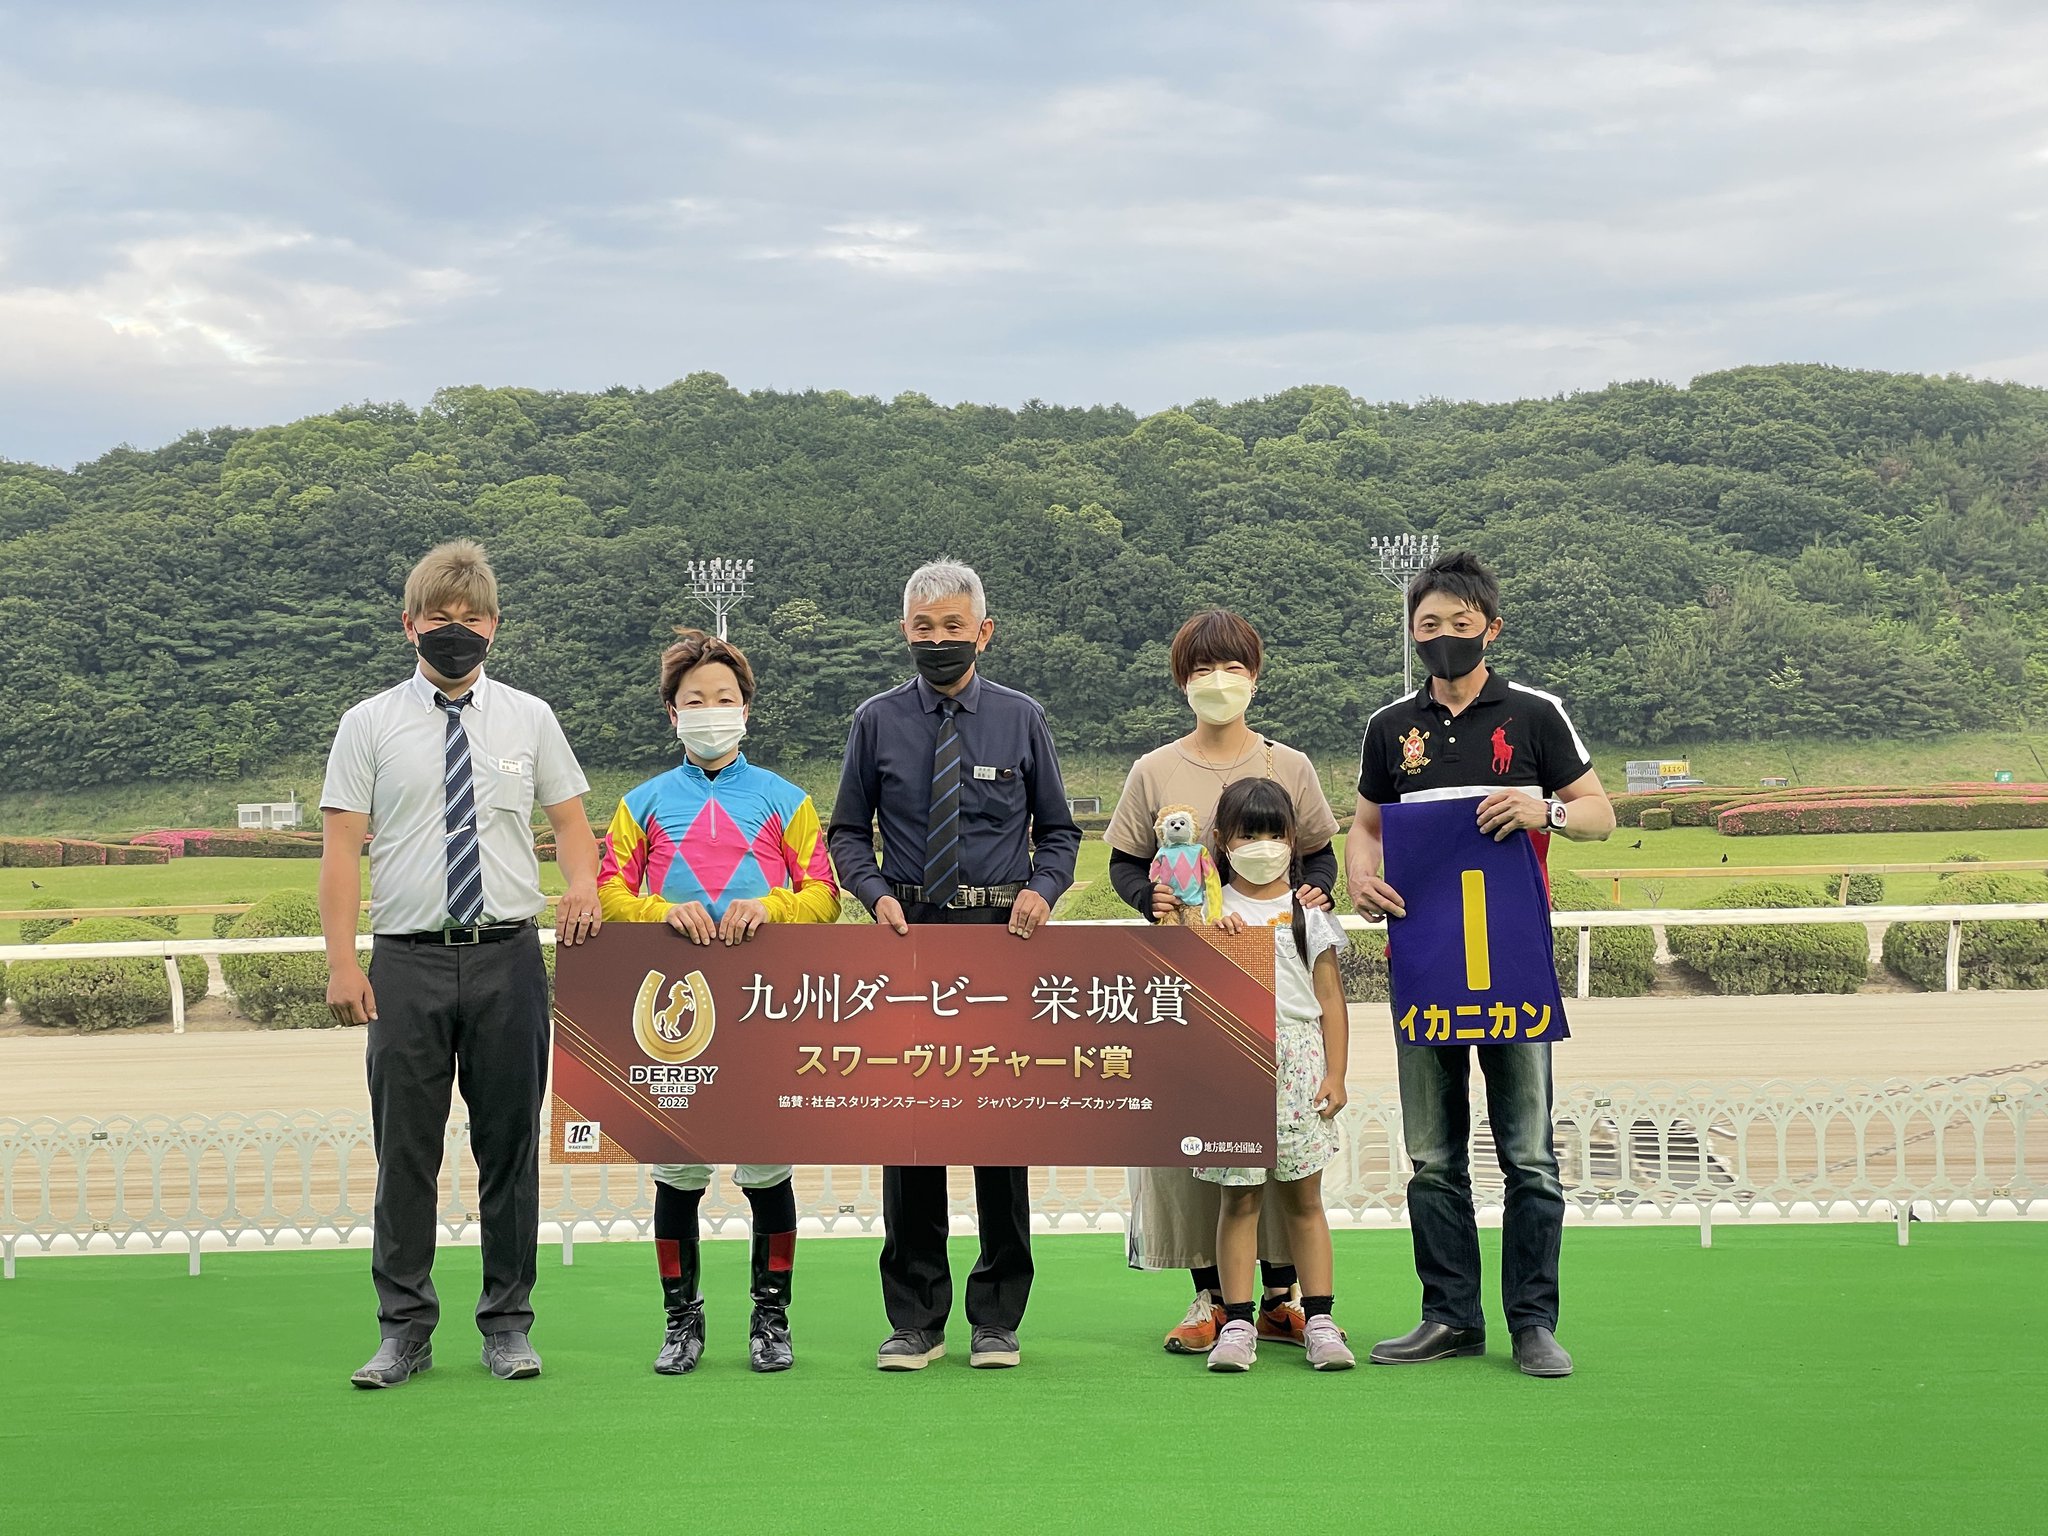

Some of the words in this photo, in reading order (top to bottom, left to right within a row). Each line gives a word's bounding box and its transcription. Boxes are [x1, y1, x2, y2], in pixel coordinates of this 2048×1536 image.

[1462, 870, 1491, 990] 1
[738, 973, 1009, 1024] 九州ダービー
[1031, 973, 1193, 1026] 栄城賞
[1399, 1001, 1552, 1041] イカニカン
[630, 1066, 718, 1083] DERBY
[796, 1044, 1133, 1079] スワーヴリチャード賞
[651, 1085, 695, 1093] SERIES
[659, 1097, 688, 1107] 2022
[977, 1096, 1153, 1110] ジャパンブリーダーズカップ協会
